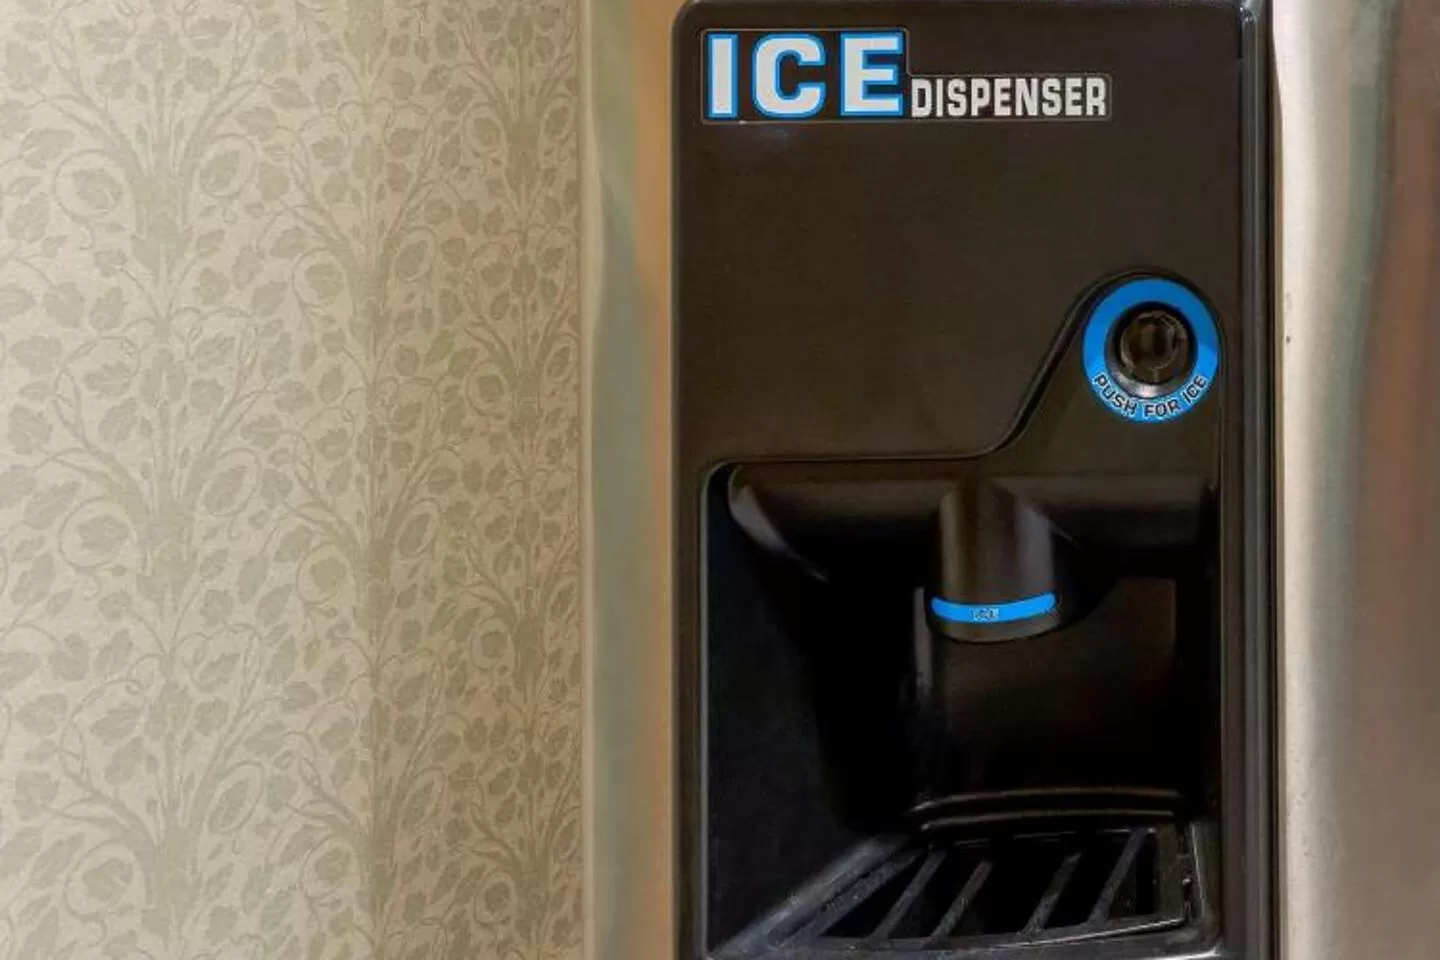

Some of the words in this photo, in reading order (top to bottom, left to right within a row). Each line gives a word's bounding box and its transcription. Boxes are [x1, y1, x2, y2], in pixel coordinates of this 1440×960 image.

[707, 32, 904, 119] ICE
[911, 78, 1107, 118] DISPENSER
[1093, 374, 1138, 416] PUSH
[1144, 400, 1182, 417] FOR
[1182, 374, 1207, 403] ICE
